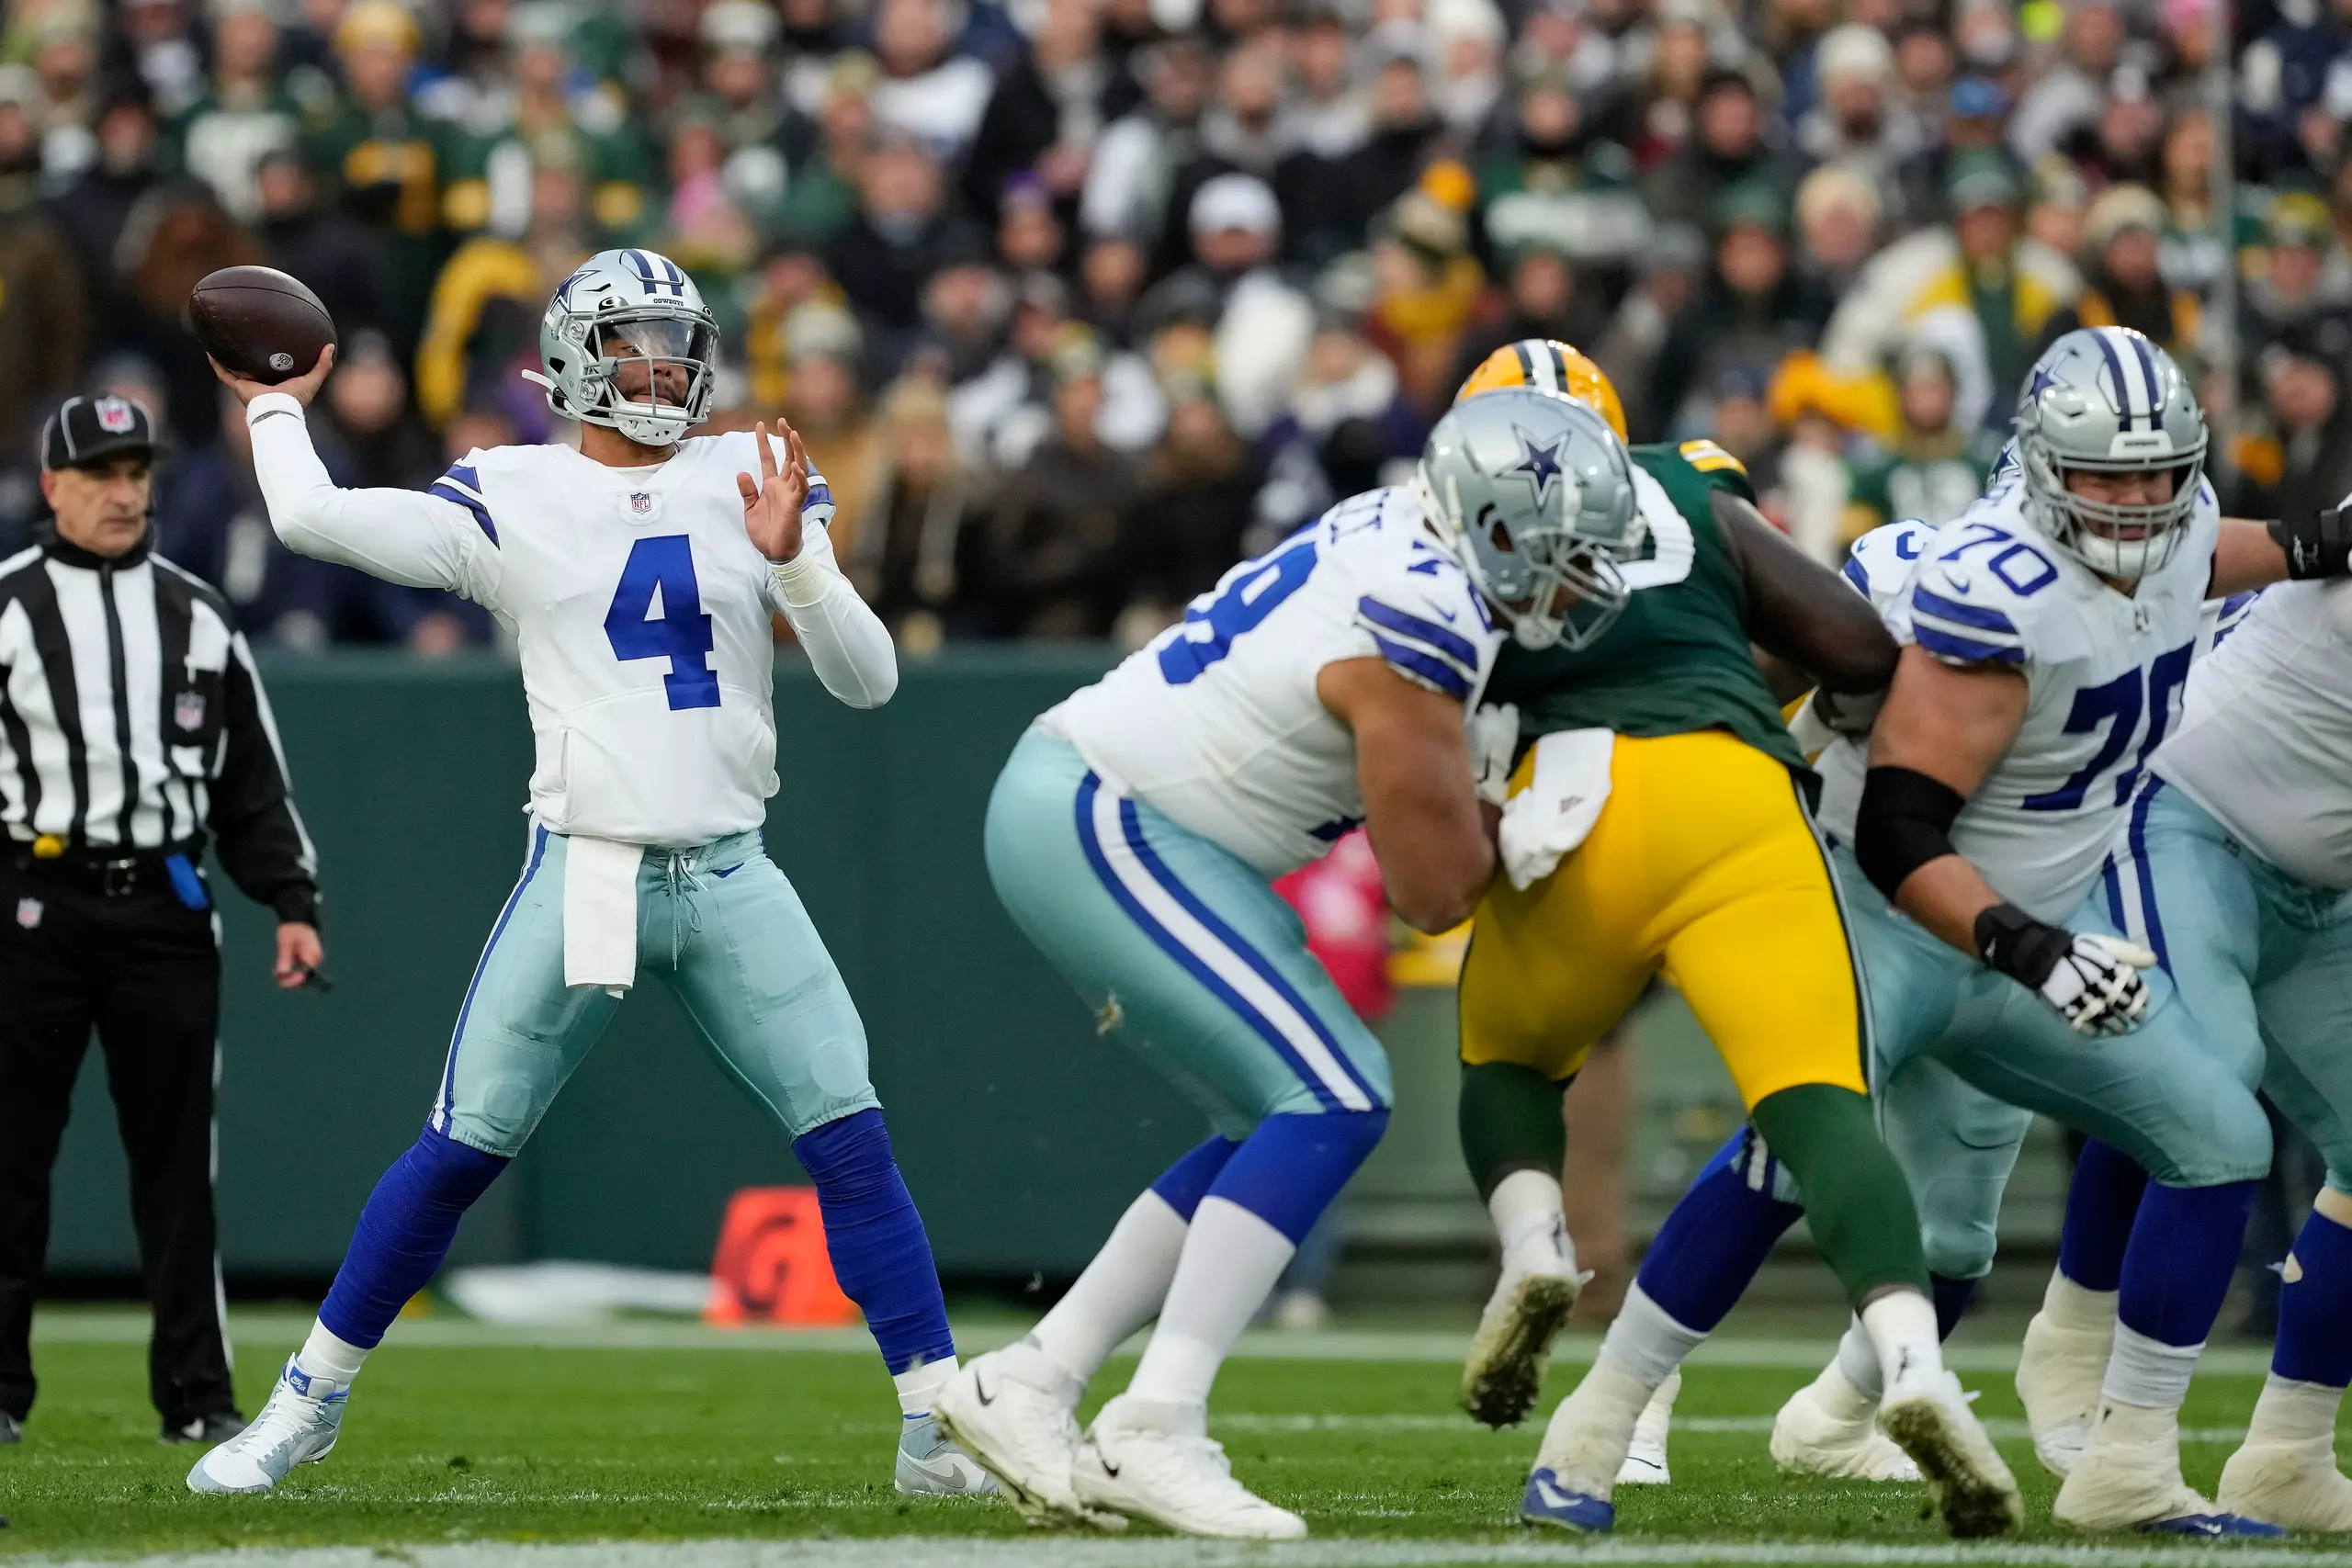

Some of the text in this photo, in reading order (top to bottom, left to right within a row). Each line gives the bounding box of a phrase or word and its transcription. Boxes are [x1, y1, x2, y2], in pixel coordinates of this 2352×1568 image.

[653, 298, 684, 307] COWBOYS
[633, 499, 649, 510] NFL
[1937, 523, 2059, 597] 70
[603, 533, 722, 711] 4
[2019, 636, 2197, 810] 70
